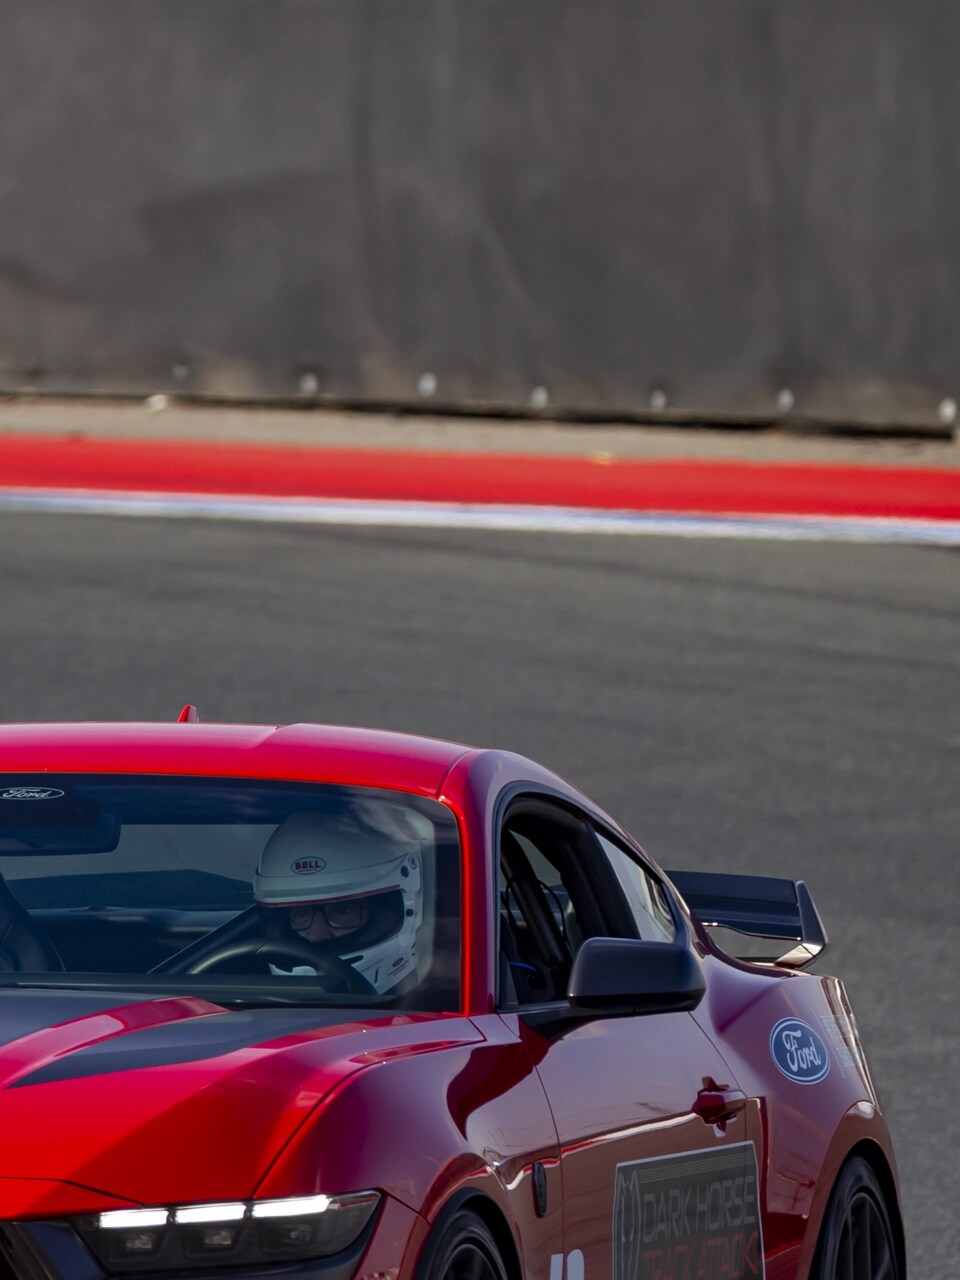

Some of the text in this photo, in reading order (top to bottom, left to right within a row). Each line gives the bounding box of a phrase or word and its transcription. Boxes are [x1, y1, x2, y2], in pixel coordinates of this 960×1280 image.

[295, 861, 322, 870] BELL
[782, 1029, 821, 1073] Ford
[643, 1176, 755, 1243] DARK HORSE
